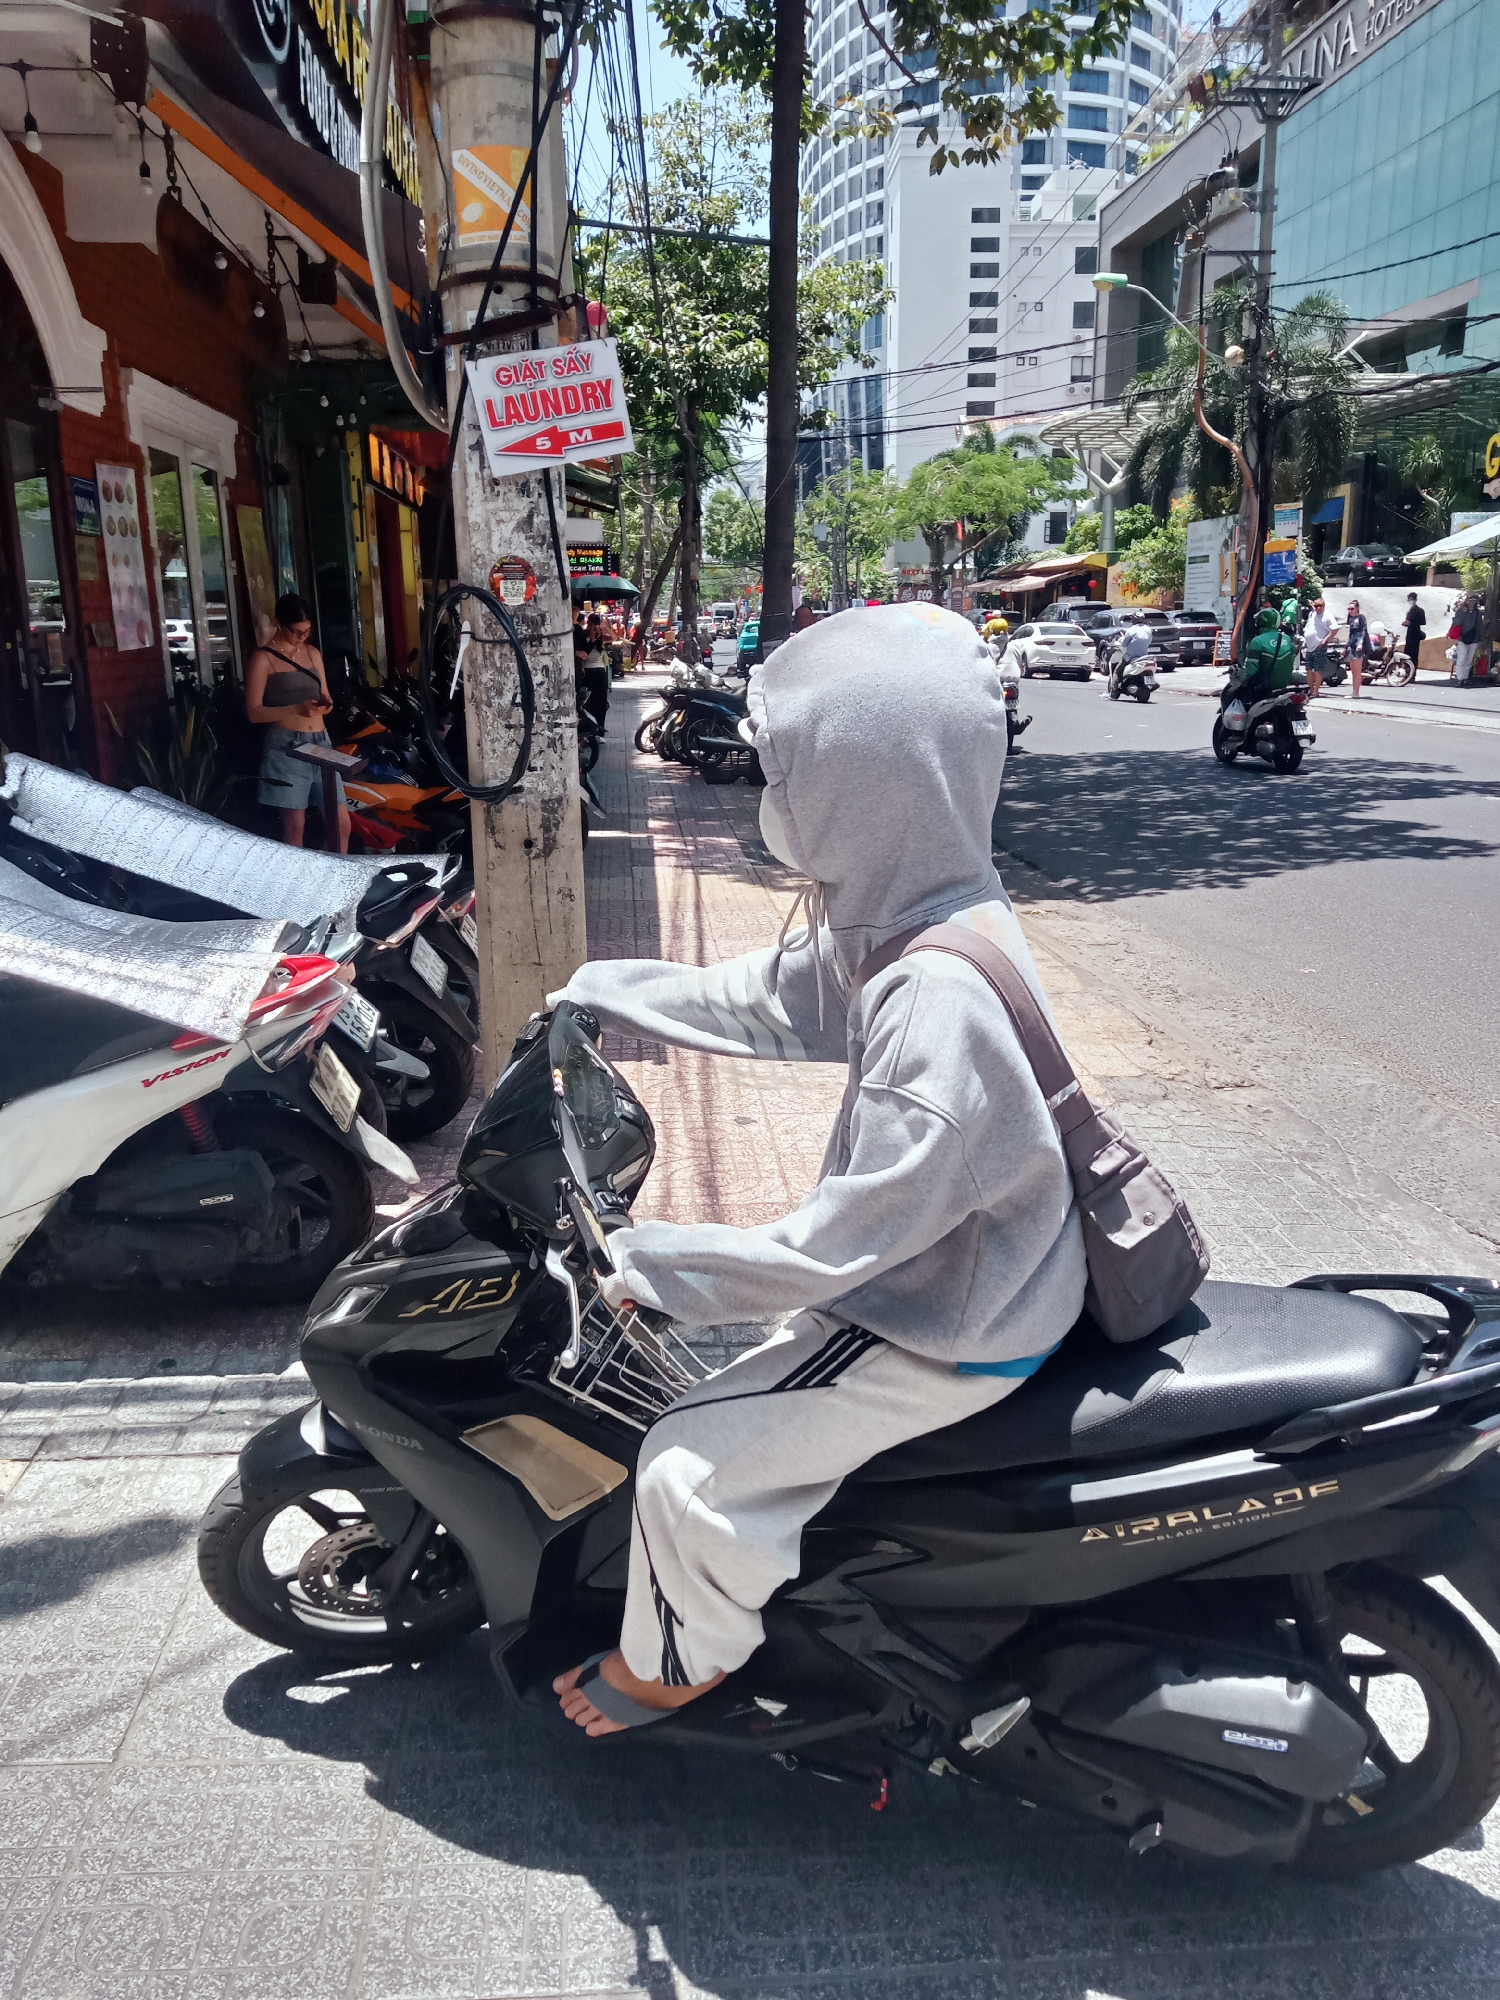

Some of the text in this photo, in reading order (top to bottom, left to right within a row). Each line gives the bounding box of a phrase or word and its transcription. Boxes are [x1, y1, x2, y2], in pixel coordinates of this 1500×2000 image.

[298, 24, 330, 144] FOOD
[458, 153, 531, 227] DIVINGVIETNACO
[495, 346, 592, 389] GIẶT SẤY
[485, 378, 613, 430] LAUNDRY
[535, 428, 593, 450] 5 M
[349, 999, 376, 1044] 150.09
[141, 1047, 232, 1088] VISION
[354, 1420, 425, 1451] HONDA
[1156, 1512, 1271, 1541] BLACK EDITION
